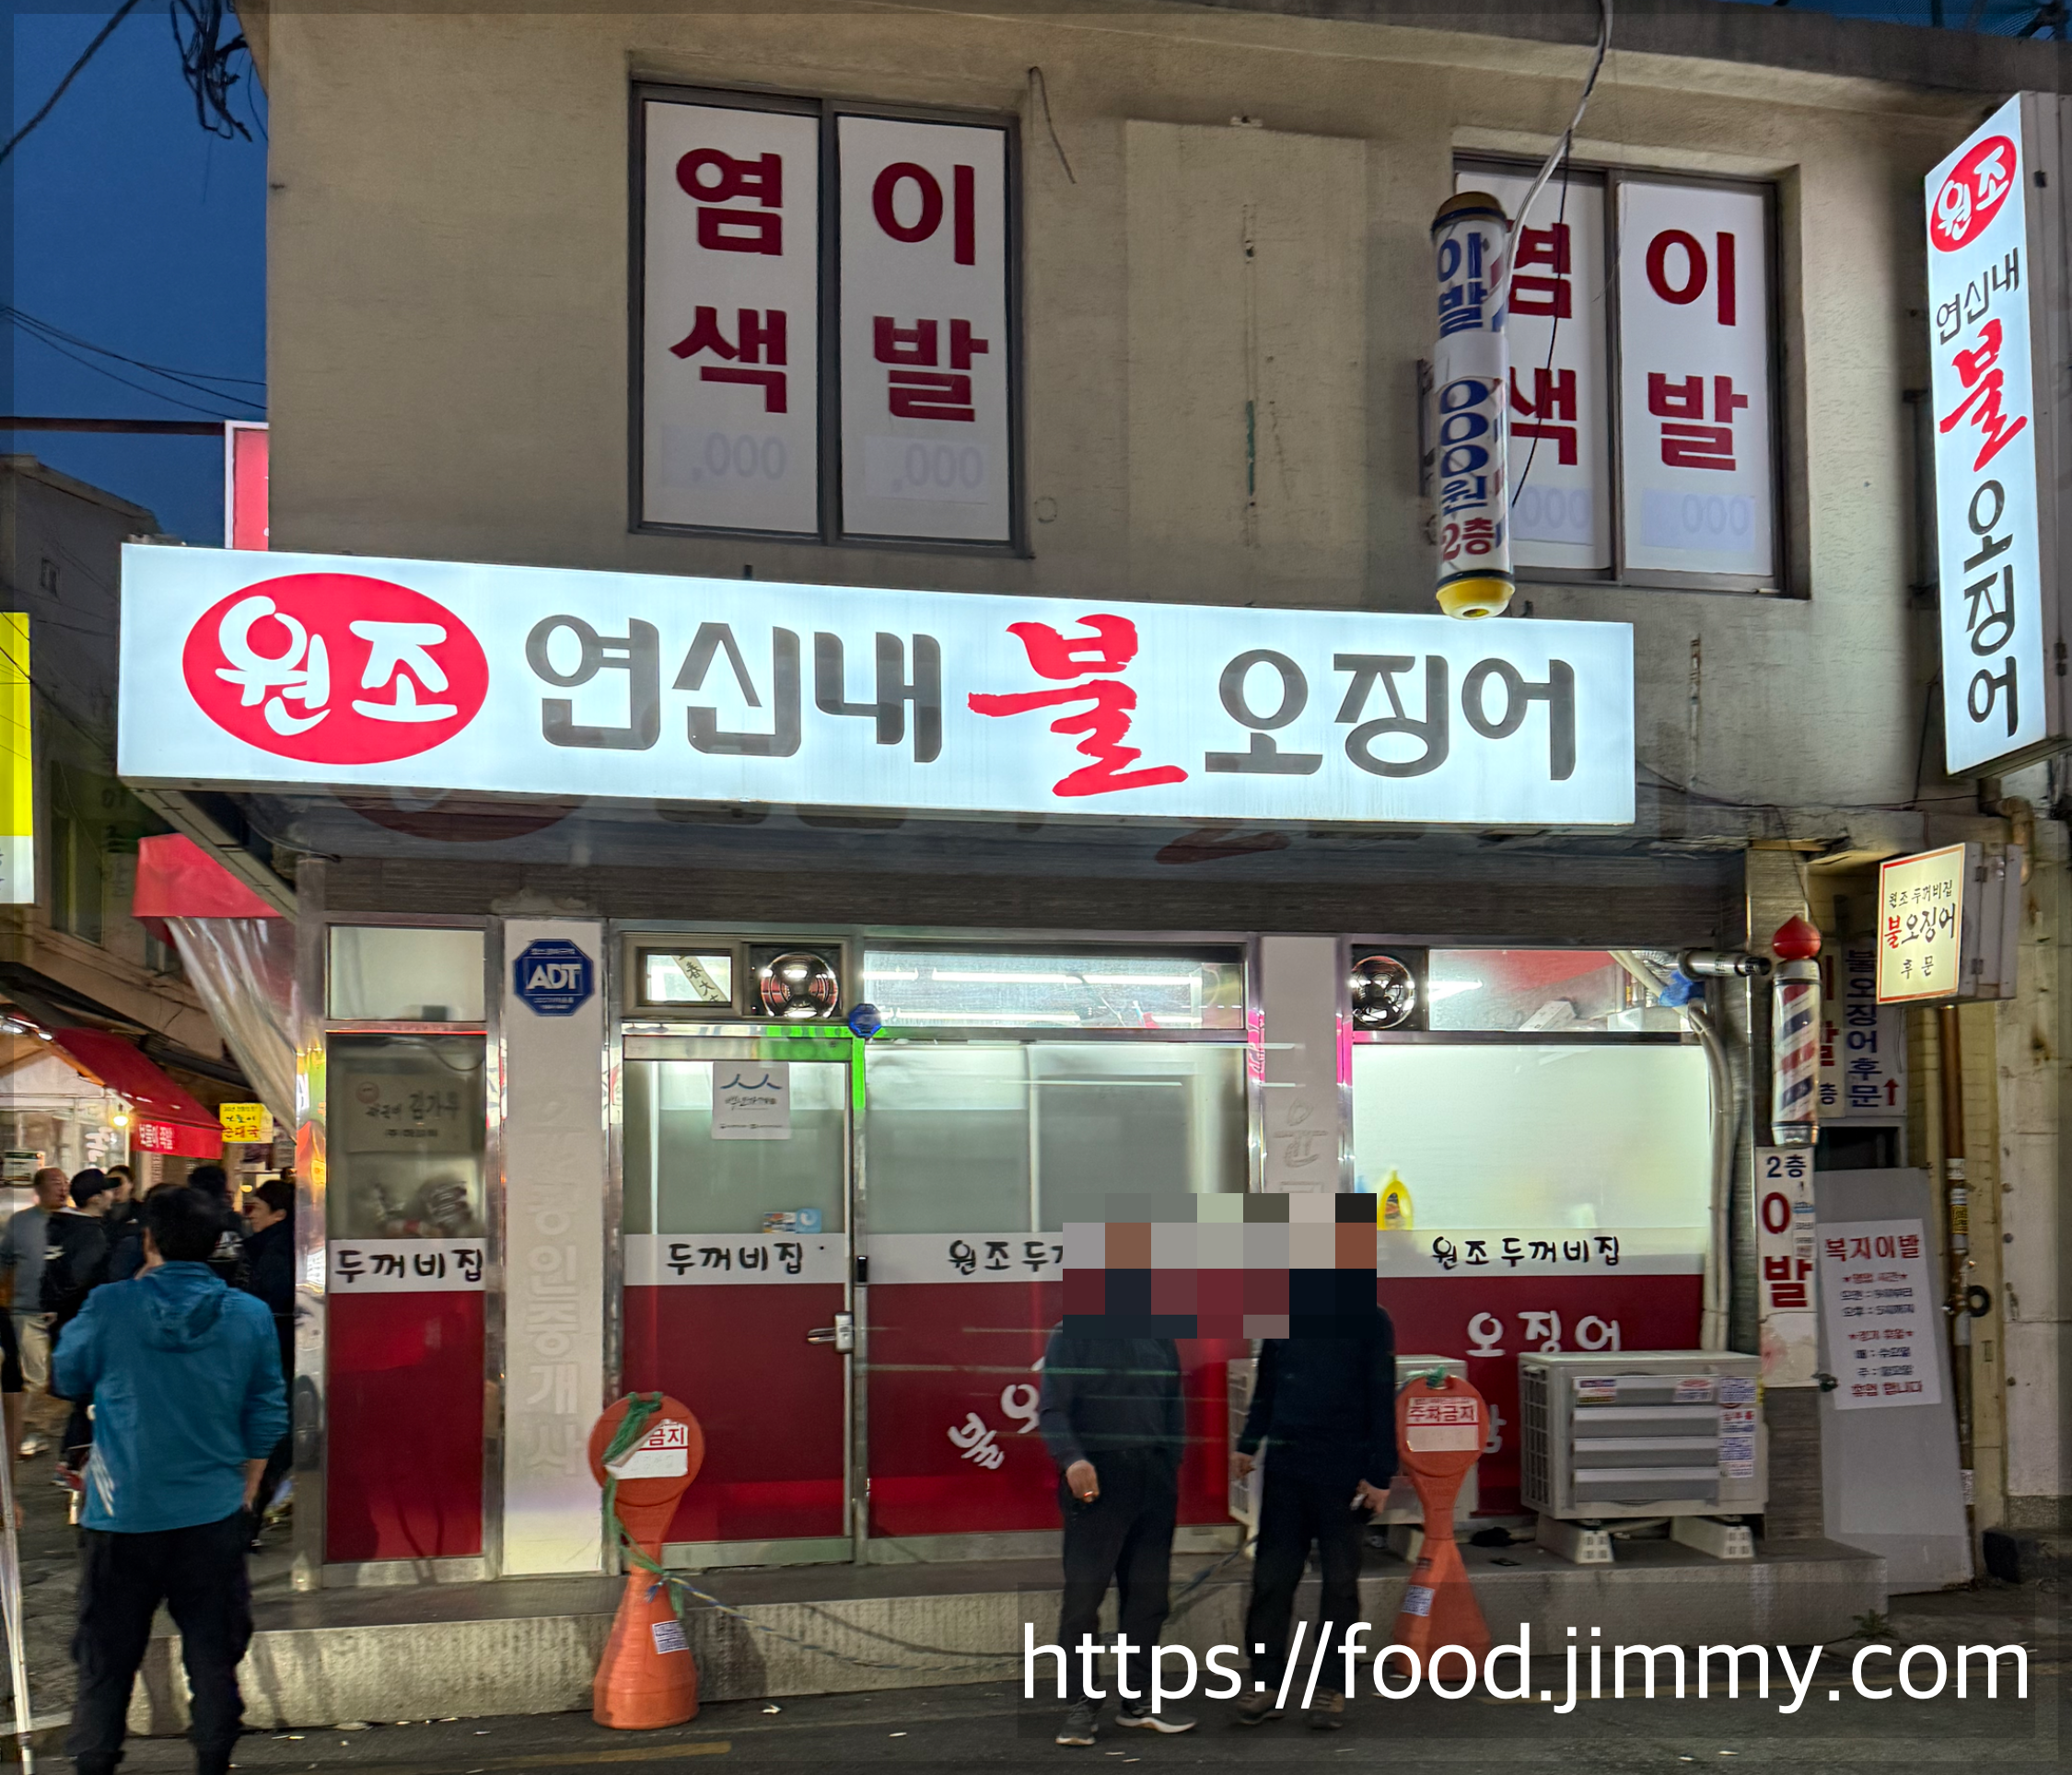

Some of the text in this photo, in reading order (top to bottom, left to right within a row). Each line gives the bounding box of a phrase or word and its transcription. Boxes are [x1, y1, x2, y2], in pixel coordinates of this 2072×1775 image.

[1936, 143, 2011, 242] 원조
[669, 147, 787, 414] 염색
[873, 161, 989, 422] 이발
[1438, 232, 1488, 338] 이발
[1936, 247, 2020, 346] 연신내
[1646, 228, 1749, 471] 이발
[1938, 318, 2029, 472] 불
[1441, 516, 1495, 562] 2층
[1962, 479, 2019, 737] 오징어
[215, 595, 1576, 797] 원조 연신내 불 오징어
[1889, 879, 1953, 910] 원조 두꺼비집
[525, 963, 583, 990] ADT
[1901, 956, 1935, 980] 후문
[1766, 1154, 1807, 1178] 2층
[334, 1248, 484, 1282] 두꺼비집
[667, 1242, 803, 1275] 두꺼비집
[948, 1239, 1064, 1276] 원조 두
[1431, 1236, 1621, 1270] 원조 두꺼비집
[1825, 1234, 1921, 1262] 복지이발
[1466, 1310, 1621, 1358] 오징어
[1409, 1405, 1474, 1422] 주차금지
